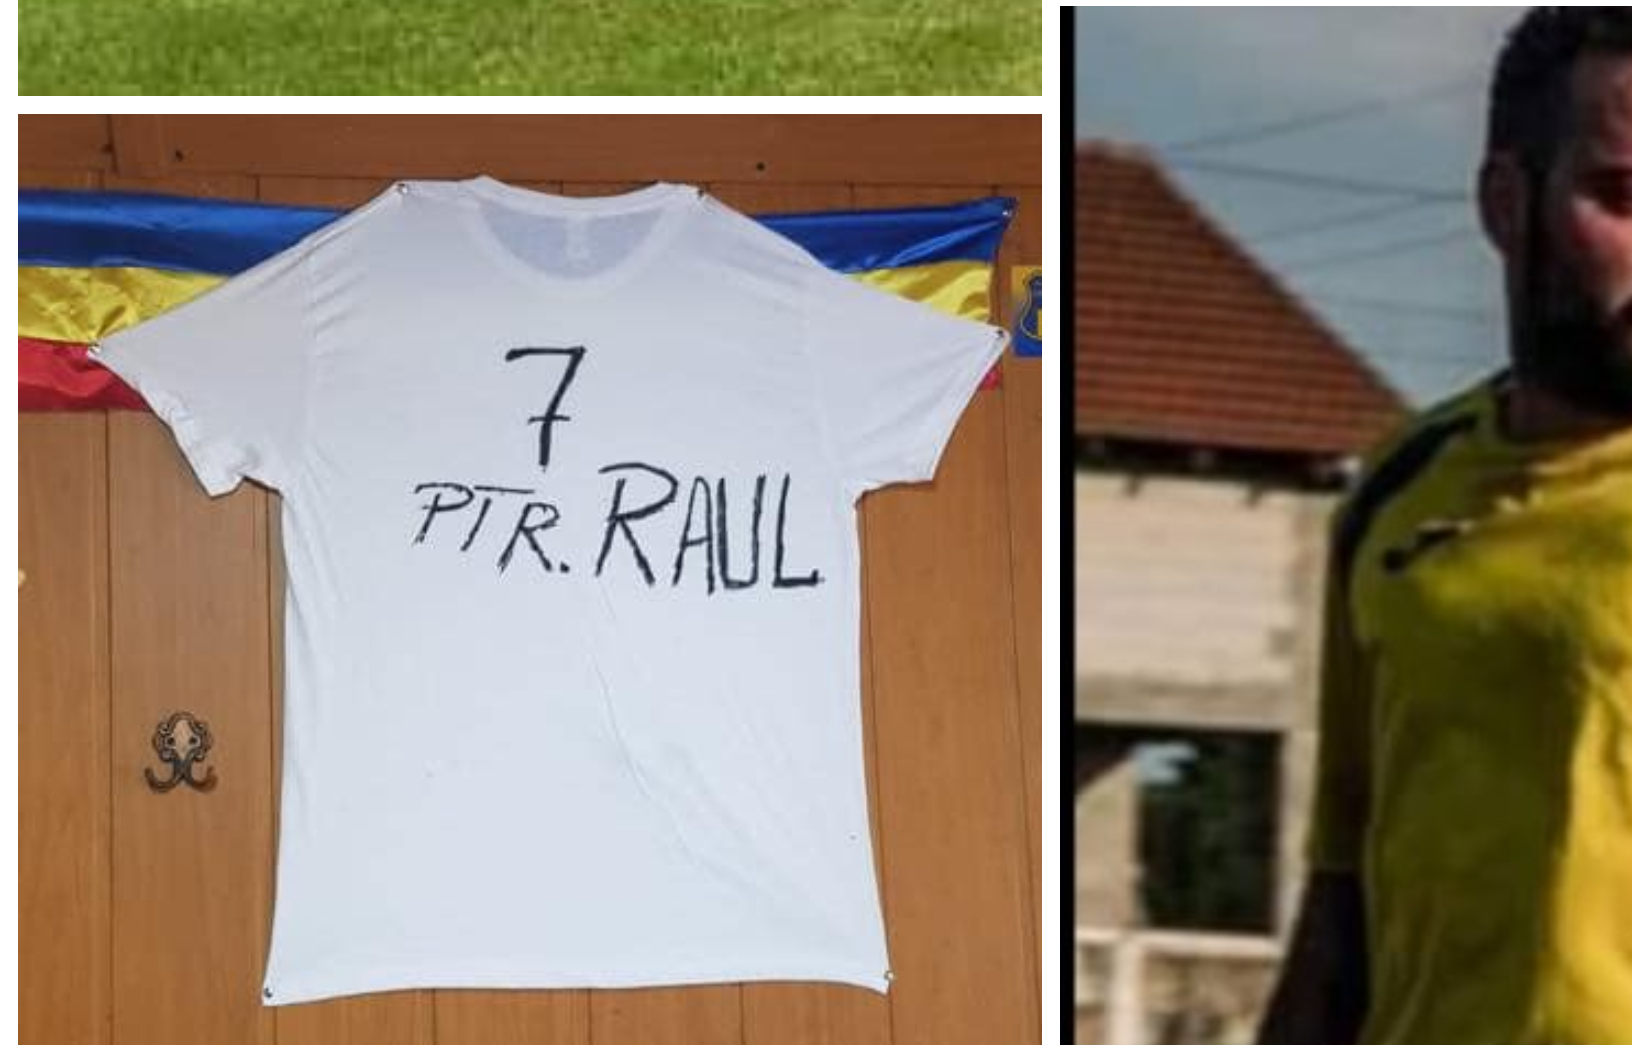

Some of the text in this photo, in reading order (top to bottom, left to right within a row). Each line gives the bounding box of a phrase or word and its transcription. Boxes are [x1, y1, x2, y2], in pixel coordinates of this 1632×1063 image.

[505, 346, 587, 471] 7
[412, 462, 824, 596] PTR. RAUL
